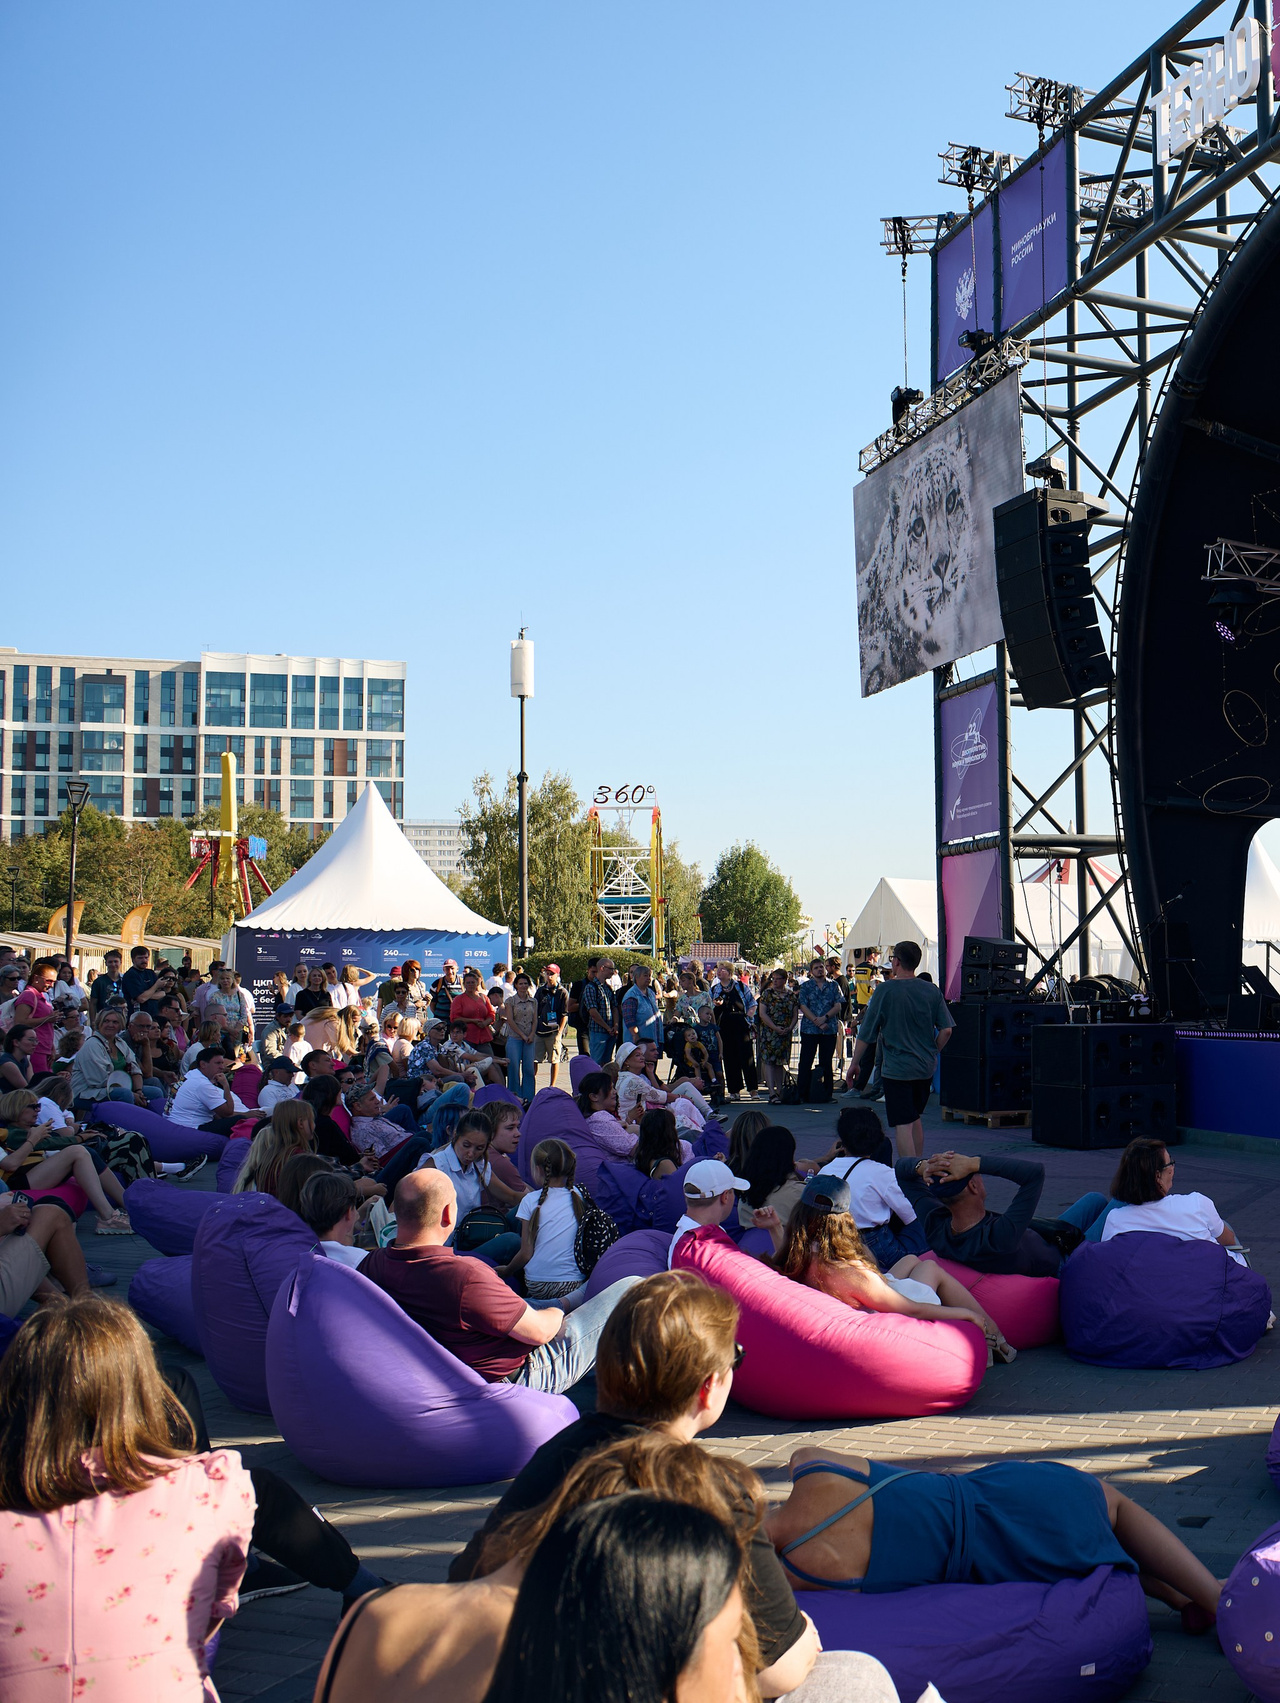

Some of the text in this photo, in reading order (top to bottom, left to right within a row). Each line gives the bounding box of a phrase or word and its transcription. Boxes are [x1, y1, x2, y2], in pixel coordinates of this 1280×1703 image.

[1149, 16, 1261, 166] ТЕХНО
[1011, 211, 1058, 255] МИНОБРНАУКИ
[1011, 241, 1034, 268] РОССИИ
[253, 979, 273, 988] ЦКП
